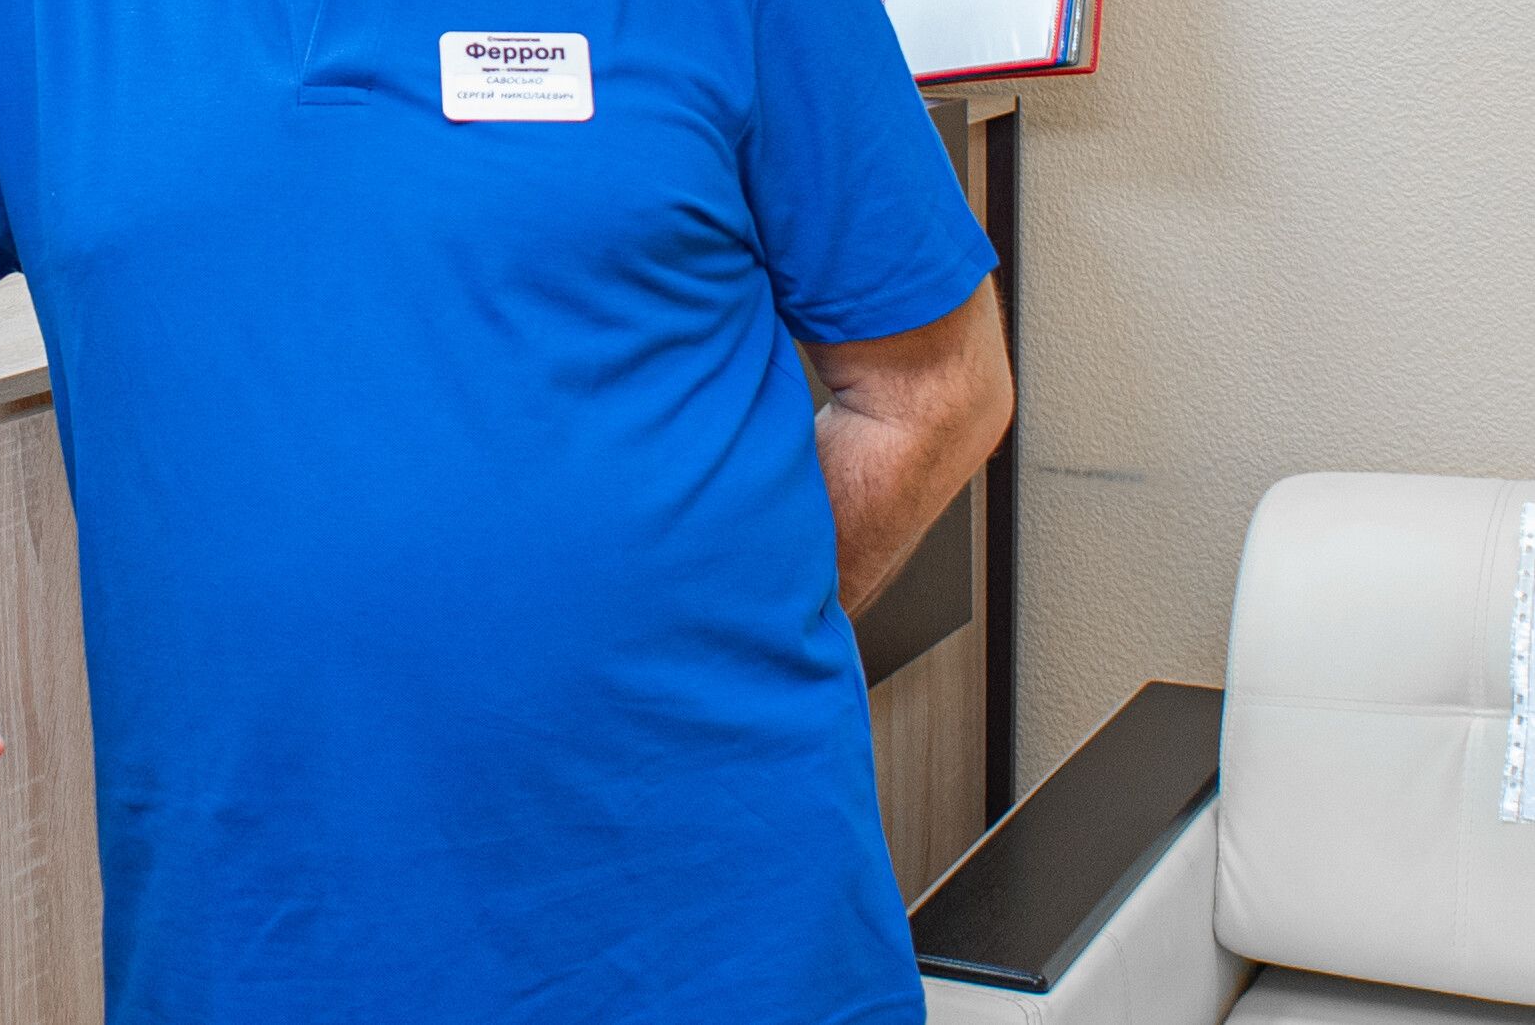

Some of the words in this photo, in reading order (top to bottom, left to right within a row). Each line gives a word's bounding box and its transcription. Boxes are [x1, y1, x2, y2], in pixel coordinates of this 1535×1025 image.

[466, 42, 565, 64] Феррол
[457, 91, 495, 100] СЕРГЕЙ
[500, 92, 574, 100] НИКОЛАЕВИЧ
